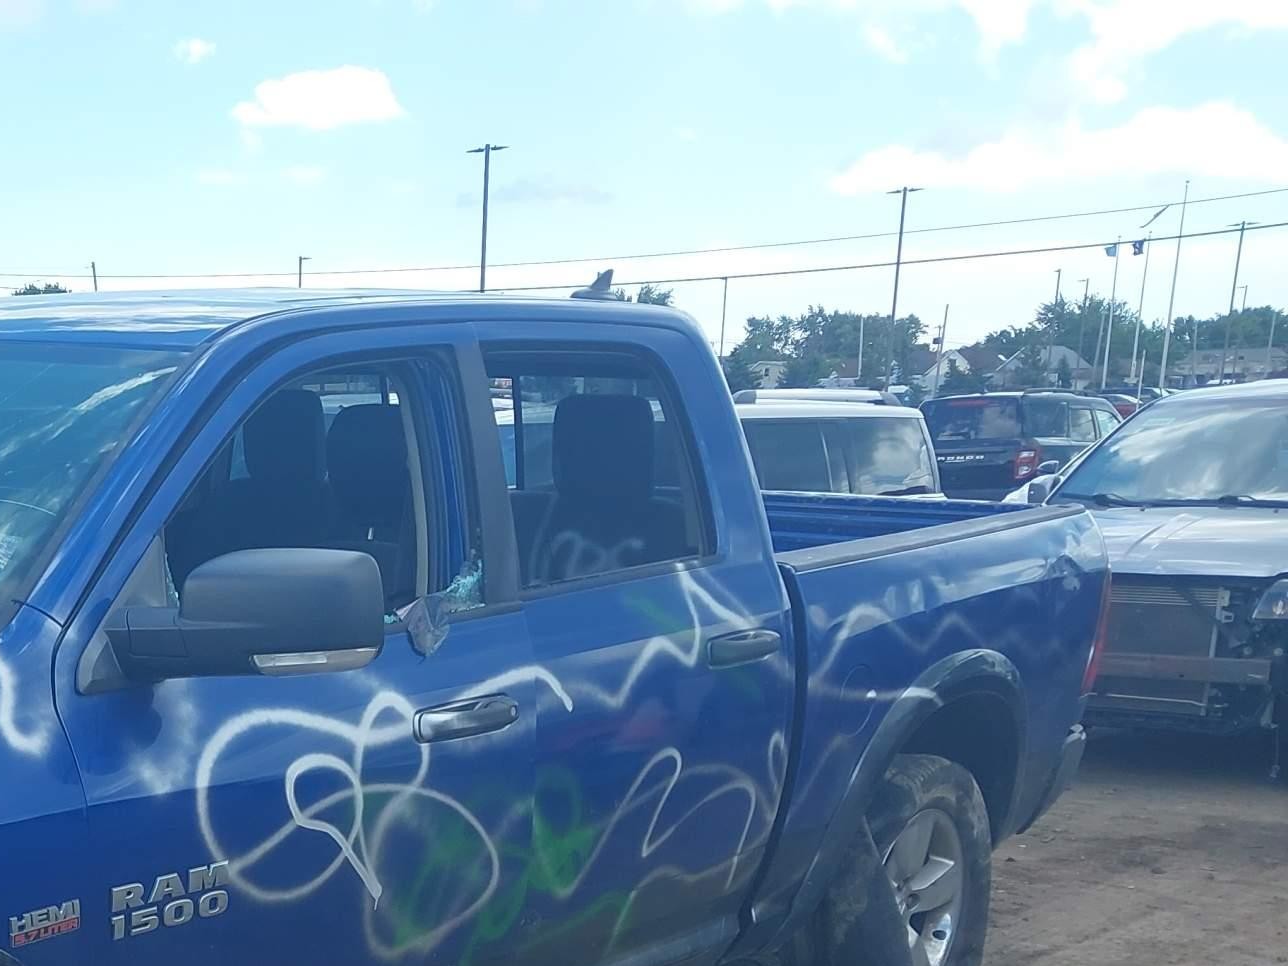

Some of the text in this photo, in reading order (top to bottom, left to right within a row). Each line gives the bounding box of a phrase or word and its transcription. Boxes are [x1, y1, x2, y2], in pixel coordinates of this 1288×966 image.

[110, 859, 230, 913] RAM
[9, 898, 80, 934] HEMI
[13, 917, 79, 945] 5.7 LITER
[110, 889, 230, 941] 1500
